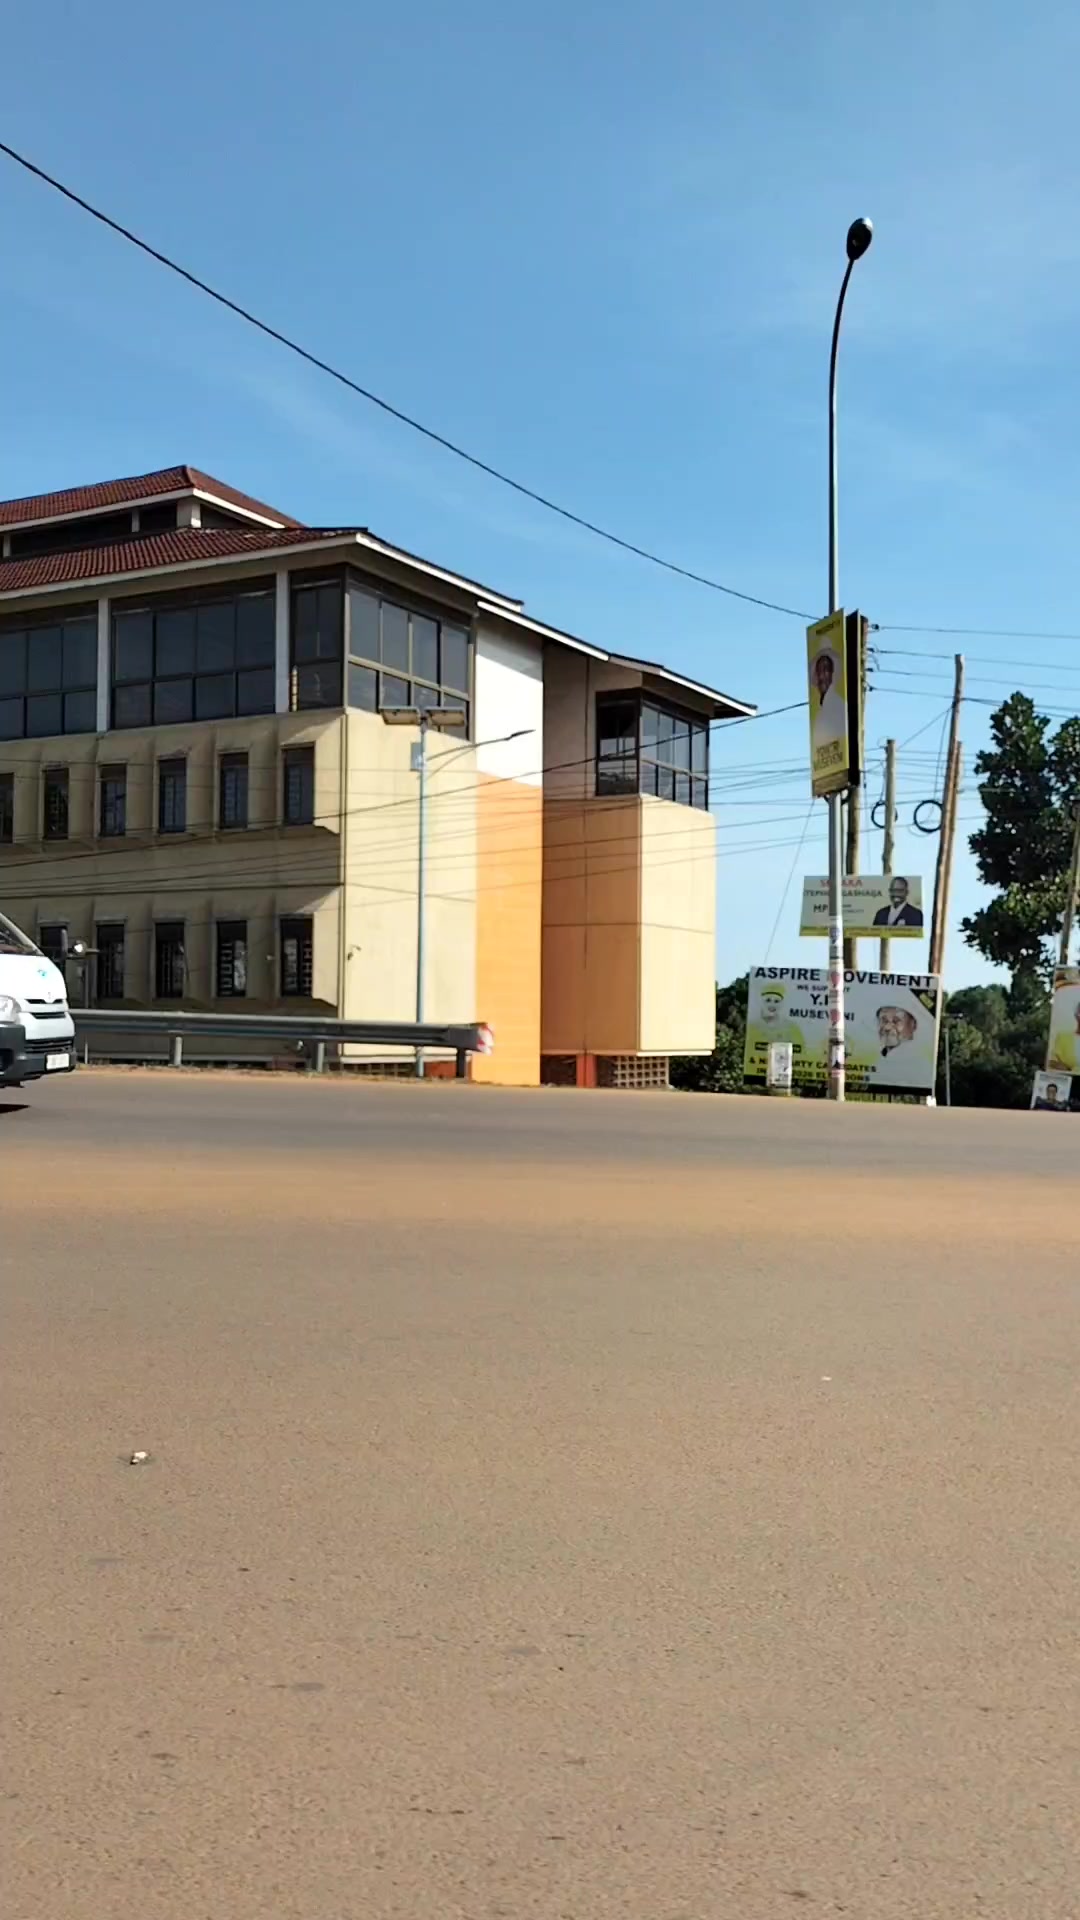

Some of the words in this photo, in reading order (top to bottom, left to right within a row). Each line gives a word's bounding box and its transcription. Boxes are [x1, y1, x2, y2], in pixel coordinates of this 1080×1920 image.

[754, 967, 820, 982] ASPIRE
[832, 970, 933, 987] OVEMENT
[790, 1008, 855, 1021] MUSEVNI
